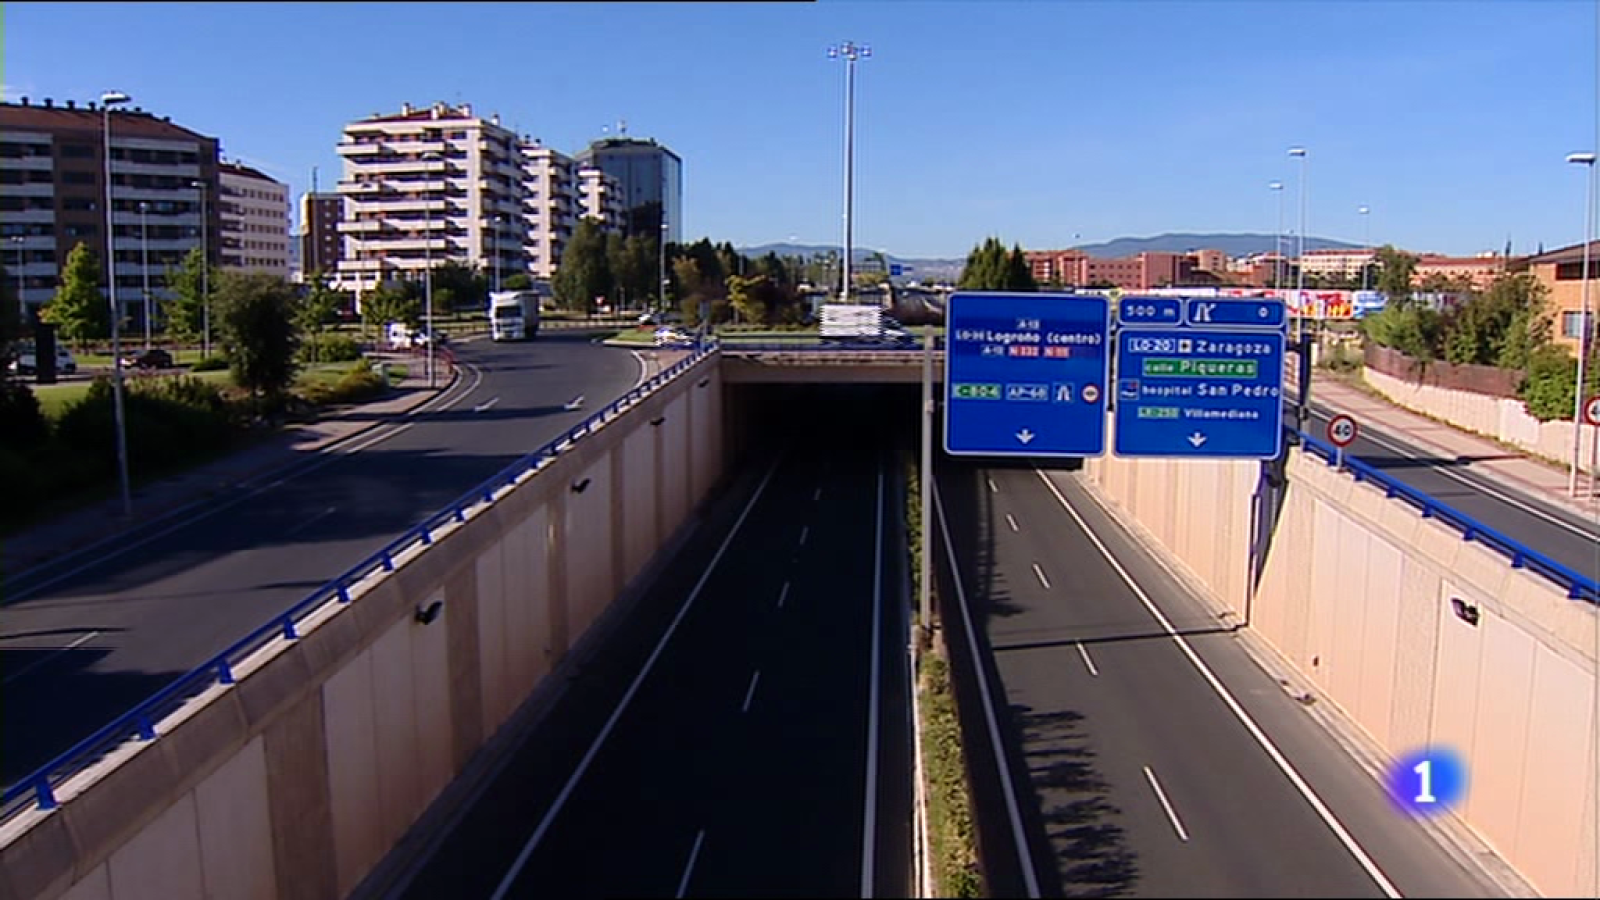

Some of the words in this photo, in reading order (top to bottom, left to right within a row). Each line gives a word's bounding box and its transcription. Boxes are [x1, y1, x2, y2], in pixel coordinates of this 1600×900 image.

[1126, 305, 1156, 317] 500
[1163, 307, 1176, 317] m
[986, 331, 1041, 345] Logroño
[1047, 332, 1102, 345] (centro)
[1196, 340, 1272, 356] Zaragoza
[1145, 362, 1174, 373] calle
[1179, 360, 1255, 375] Piqueras
[1142, 384, 1192, 397] hospital
[1197, 383, 1228, 397] San
[1231, 383, 1280, 398] Pedro
[1183, 408, 1259, 420] Villamediana
[1334, 423, 1351, 437] 40
